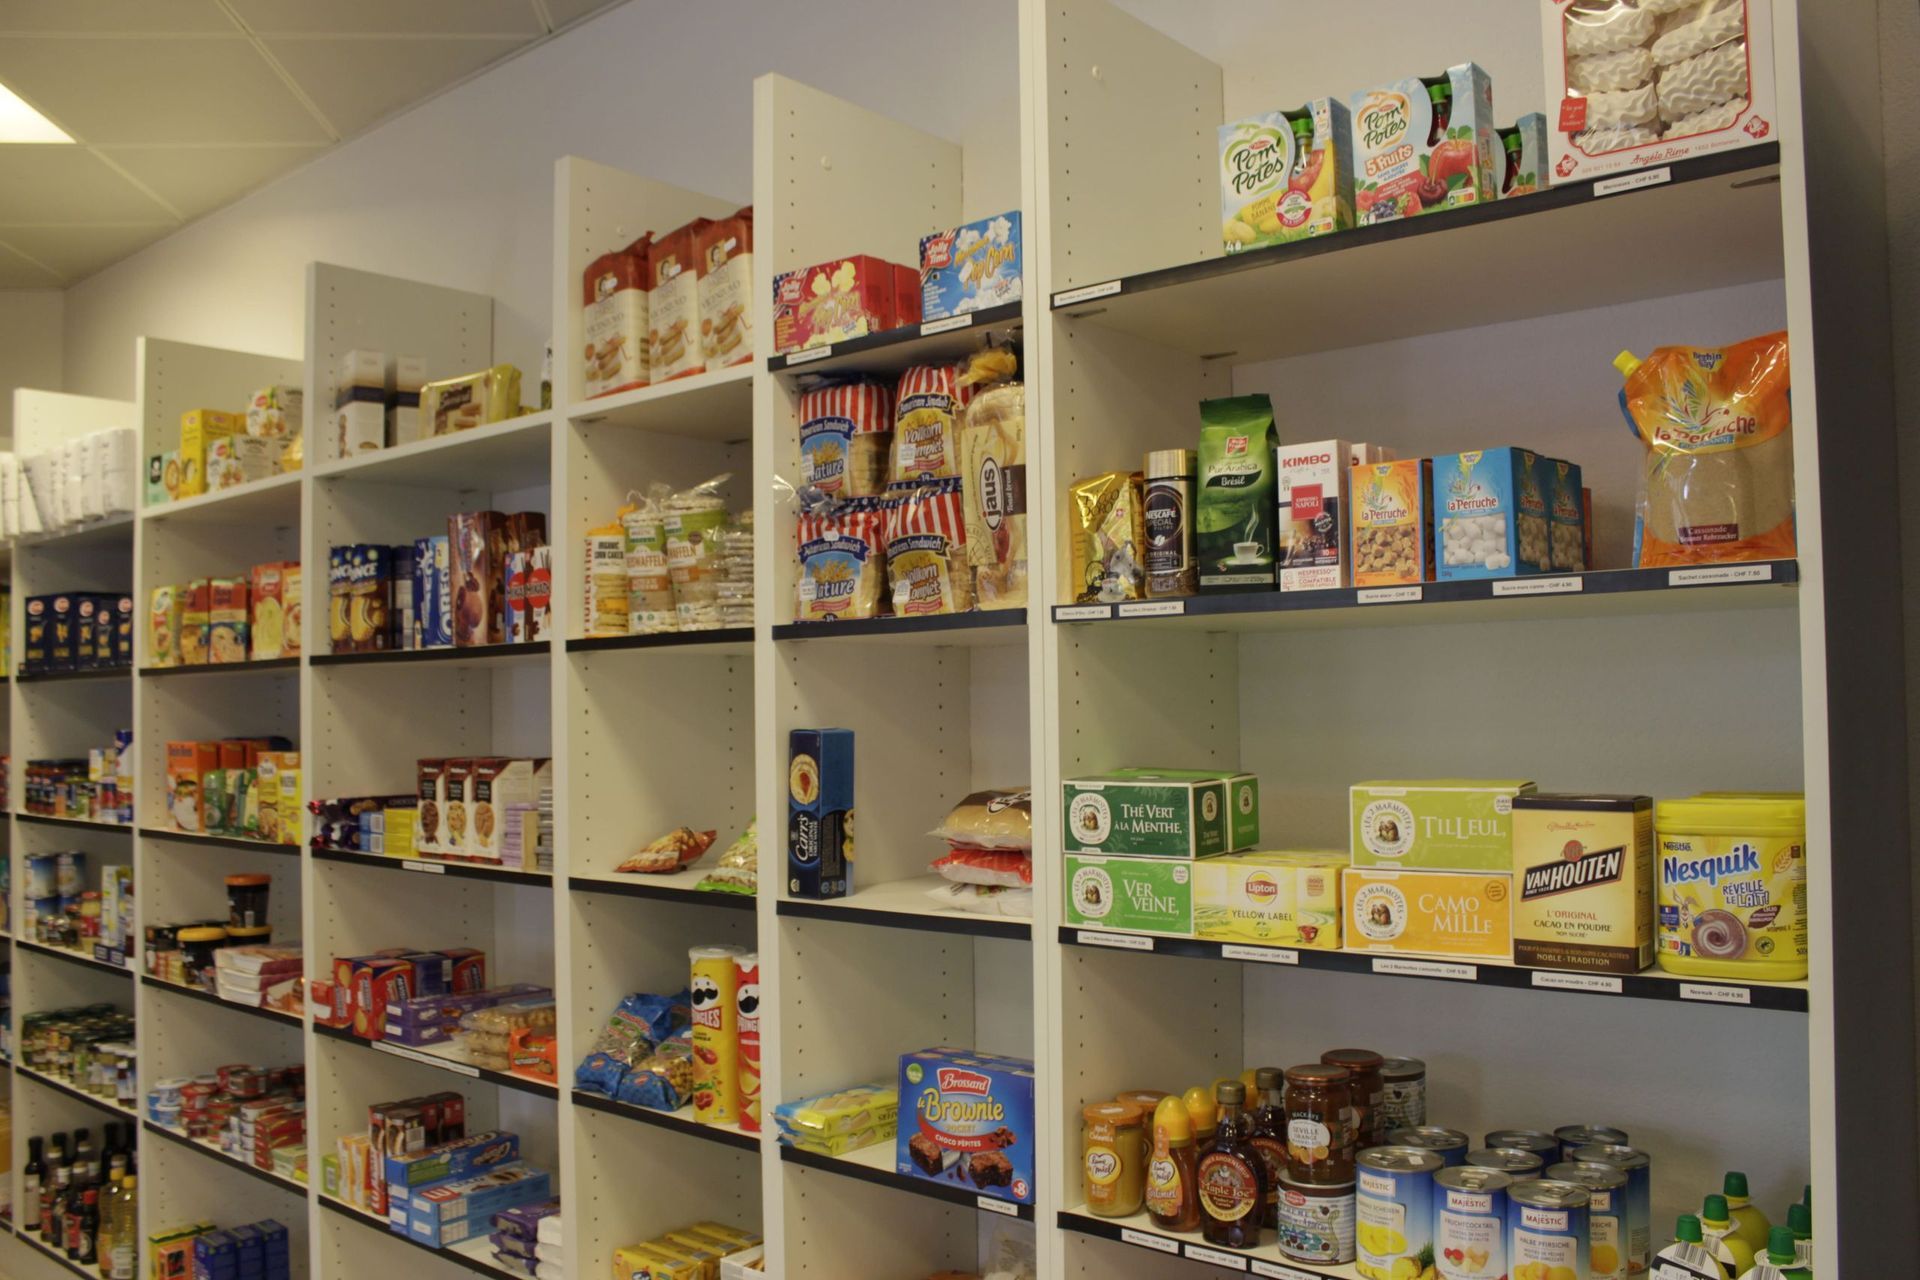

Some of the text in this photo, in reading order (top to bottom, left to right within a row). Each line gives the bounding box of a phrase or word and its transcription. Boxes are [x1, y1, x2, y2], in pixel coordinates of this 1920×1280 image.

[1363, 116, 1406, 149] Potes
[1365, 144, 1414, 177] 5 Fruits
[1665, 146, 1690, 161] Rime
[1232, 156, 1284, 194] Potes
[904, 421, 943, 443] Vollkorn
[1673, 416, 1757, 444] Perruche
[913, 441, 944, 461] mplet
[1225, 461, 1259, 473] Arabica
[1282, 453, 1331, 469] KIMBO
[1221, 476, 1246, 486] Brésil
[981, 468, 1001, 519] jaus
[1295, 500, 1320, 509] NAPOLI
[1447, 496, 1498, 511] la Perruche
[1361, 508, 1408, 520] la Perruche
[909, 537, 942, 550] Sandwich
[816, 577, 855, 600] ature
[1297, 577, 1337, 585] COMPATIBLE
[1120, 802, 1175, 818] THÉ VERT
[1120, 823, 1130, 831] LA
[1131, 819, 1183, 836] MENTHE,
[794, 814, 810, 862] Carr's
[1525, 851, 1622, 891] VAN HOUTEN
[1663, 843, 1760, 886] Nesquik
[1122, 879, 1155, 898] VER
[1247, 882, 1276, 894] Lipton
[1722, 879, 1764, 896] RÉVEILLE
[1418, 893, 1480, 914] CAMO
[1726, 890, 1770, 908] LE LAIT!
[1231, 909, 1293, 922] YELLOW LABEL
[1546, 909, 1598, 921] L'ORIGINAL
[1432, 912, 1493, 935] MILLE
[1533, 919, 1612, 933] CACAO EN POUDRE
[1565, 956, 1610, 966] TRADITION
[941, 1073, 988, 1091] Brossard
[923, 1087, 1005, 1122] Brownie
[1292, 1125, 1320, 1136] SEVILLE
[1293, 1133, 1318, 1142] ORANGE
[935, 1134, 957, 1146] CHOCO
[1361, 1178, 1392, 1192] MAJESTIC
[1451, 1197, 1487, 1209] MAJESTIC
[1525, 1214, 1564, 1226] MAJESTIC
